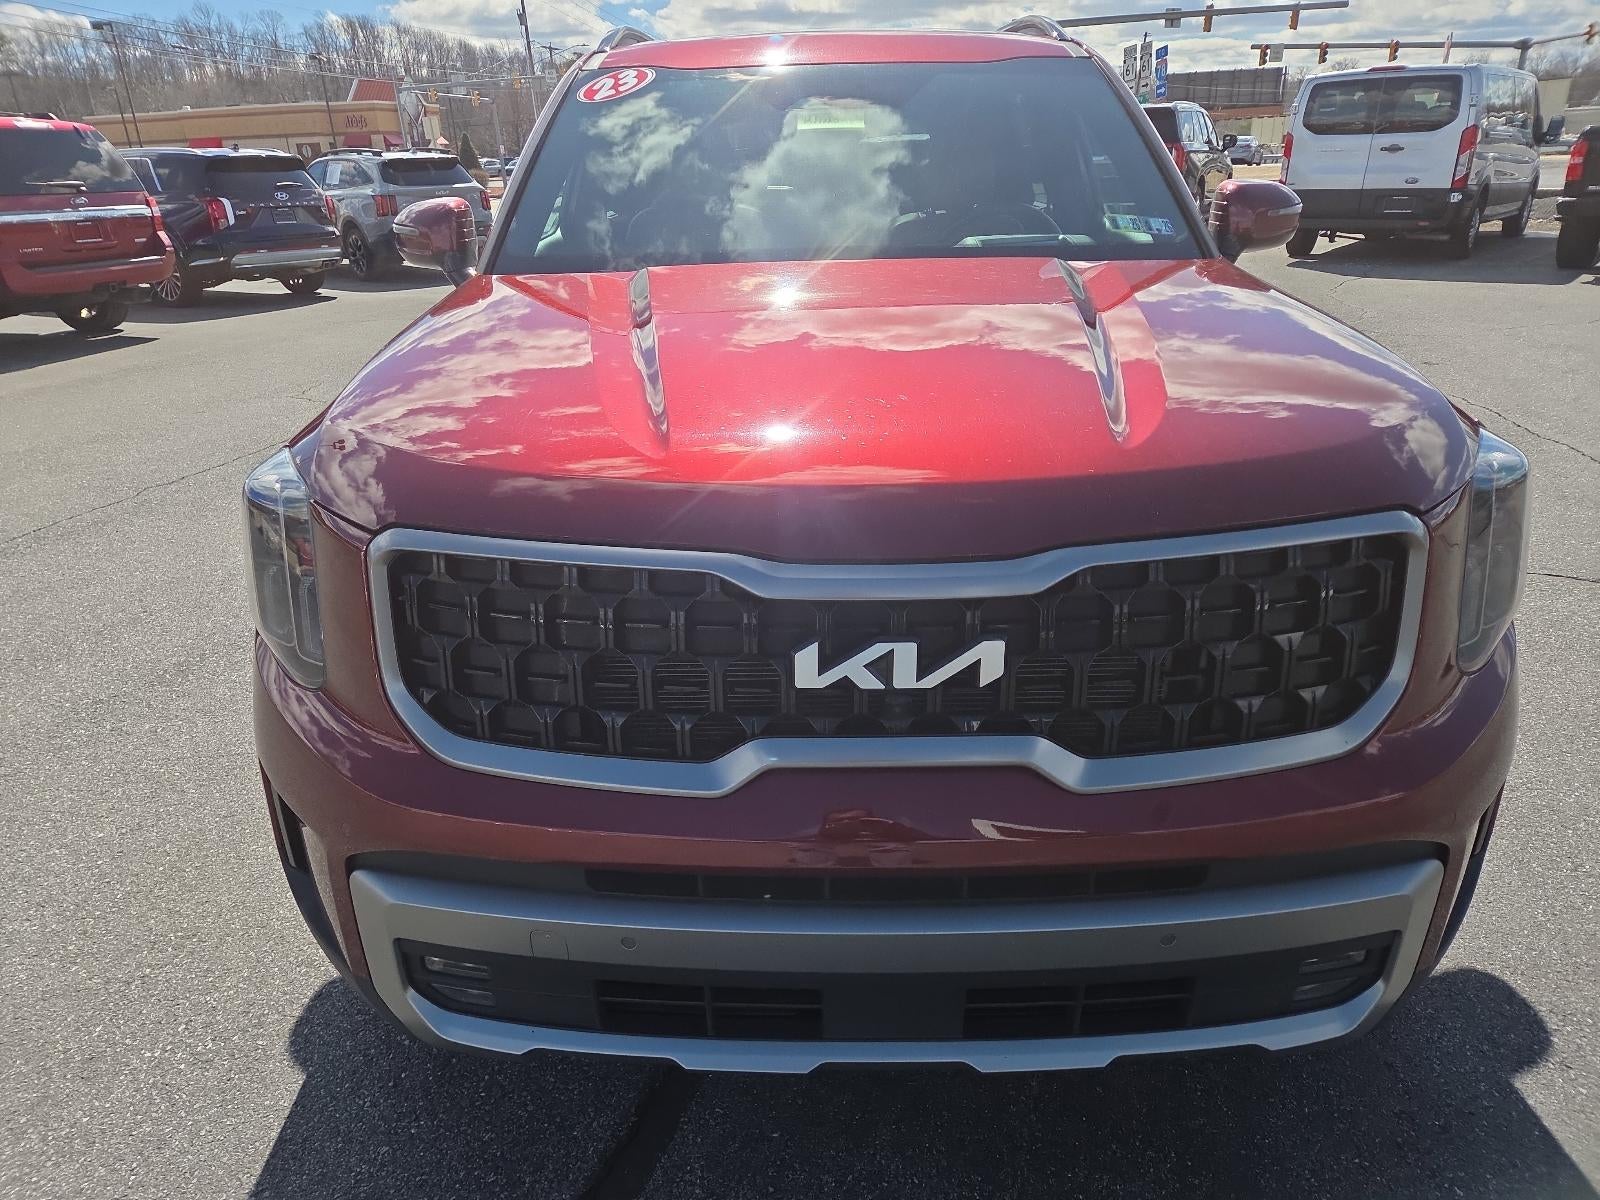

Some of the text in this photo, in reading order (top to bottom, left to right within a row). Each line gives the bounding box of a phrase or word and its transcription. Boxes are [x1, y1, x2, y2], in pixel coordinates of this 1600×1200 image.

[1125, 62, 1135, 76] 61
[1142, 59, 1150, 72] 61
[1157, 63, 1166, 78] 78
[592, 69, 639, 100] 23
